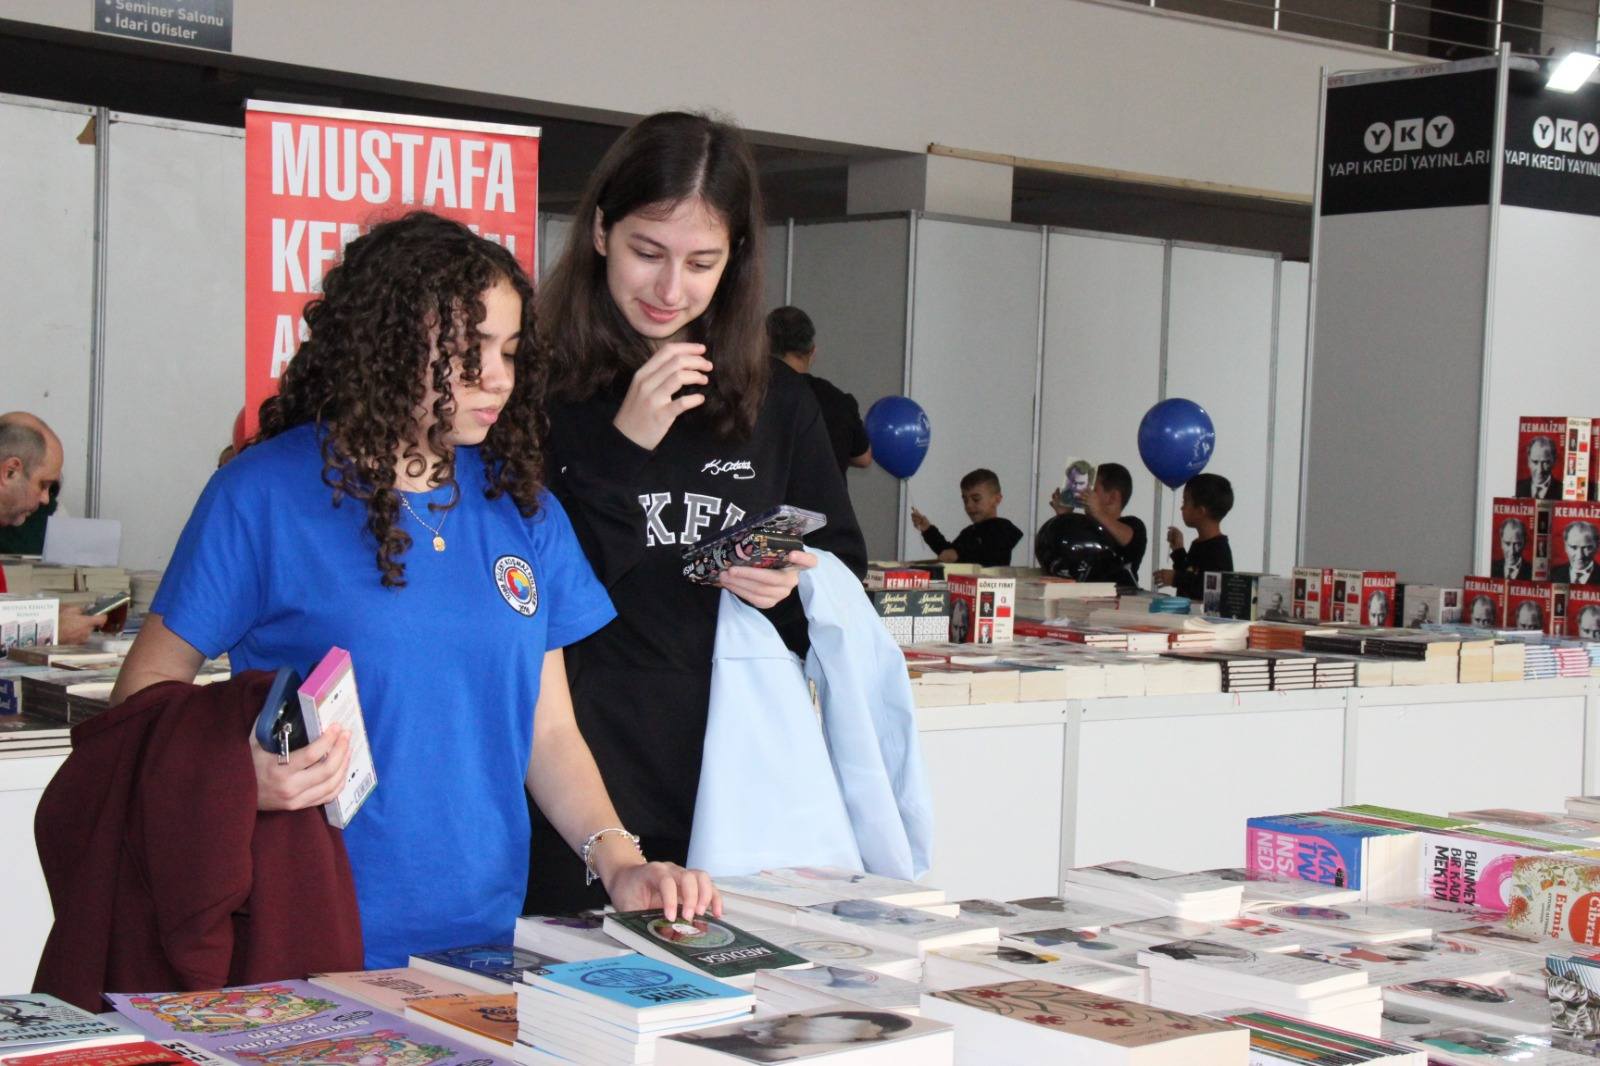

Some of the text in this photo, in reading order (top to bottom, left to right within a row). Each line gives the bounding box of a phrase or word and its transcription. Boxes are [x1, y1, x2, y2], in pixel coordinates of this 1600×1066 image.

[115, 0, 224, 27] Seminer Salonu
[115, 13, 198, 40] İdari Ofisler
[271, 121, 516, 213] MUSTAFA
[1328, 150, 1490, 177] YAPI KREDİ YAYINLARI
[1504, 150, 1530, 166] YAPI
[1531, 153, 1566, 170] KREDİ
[1521, 421, 1566, 433] KEMALİZM
[1494, 503, 1535, 516] KEMALİZM
[1510, 585, 1550, 598] KEMALİZM
[698, 947, 772, 964] MEDUSA
